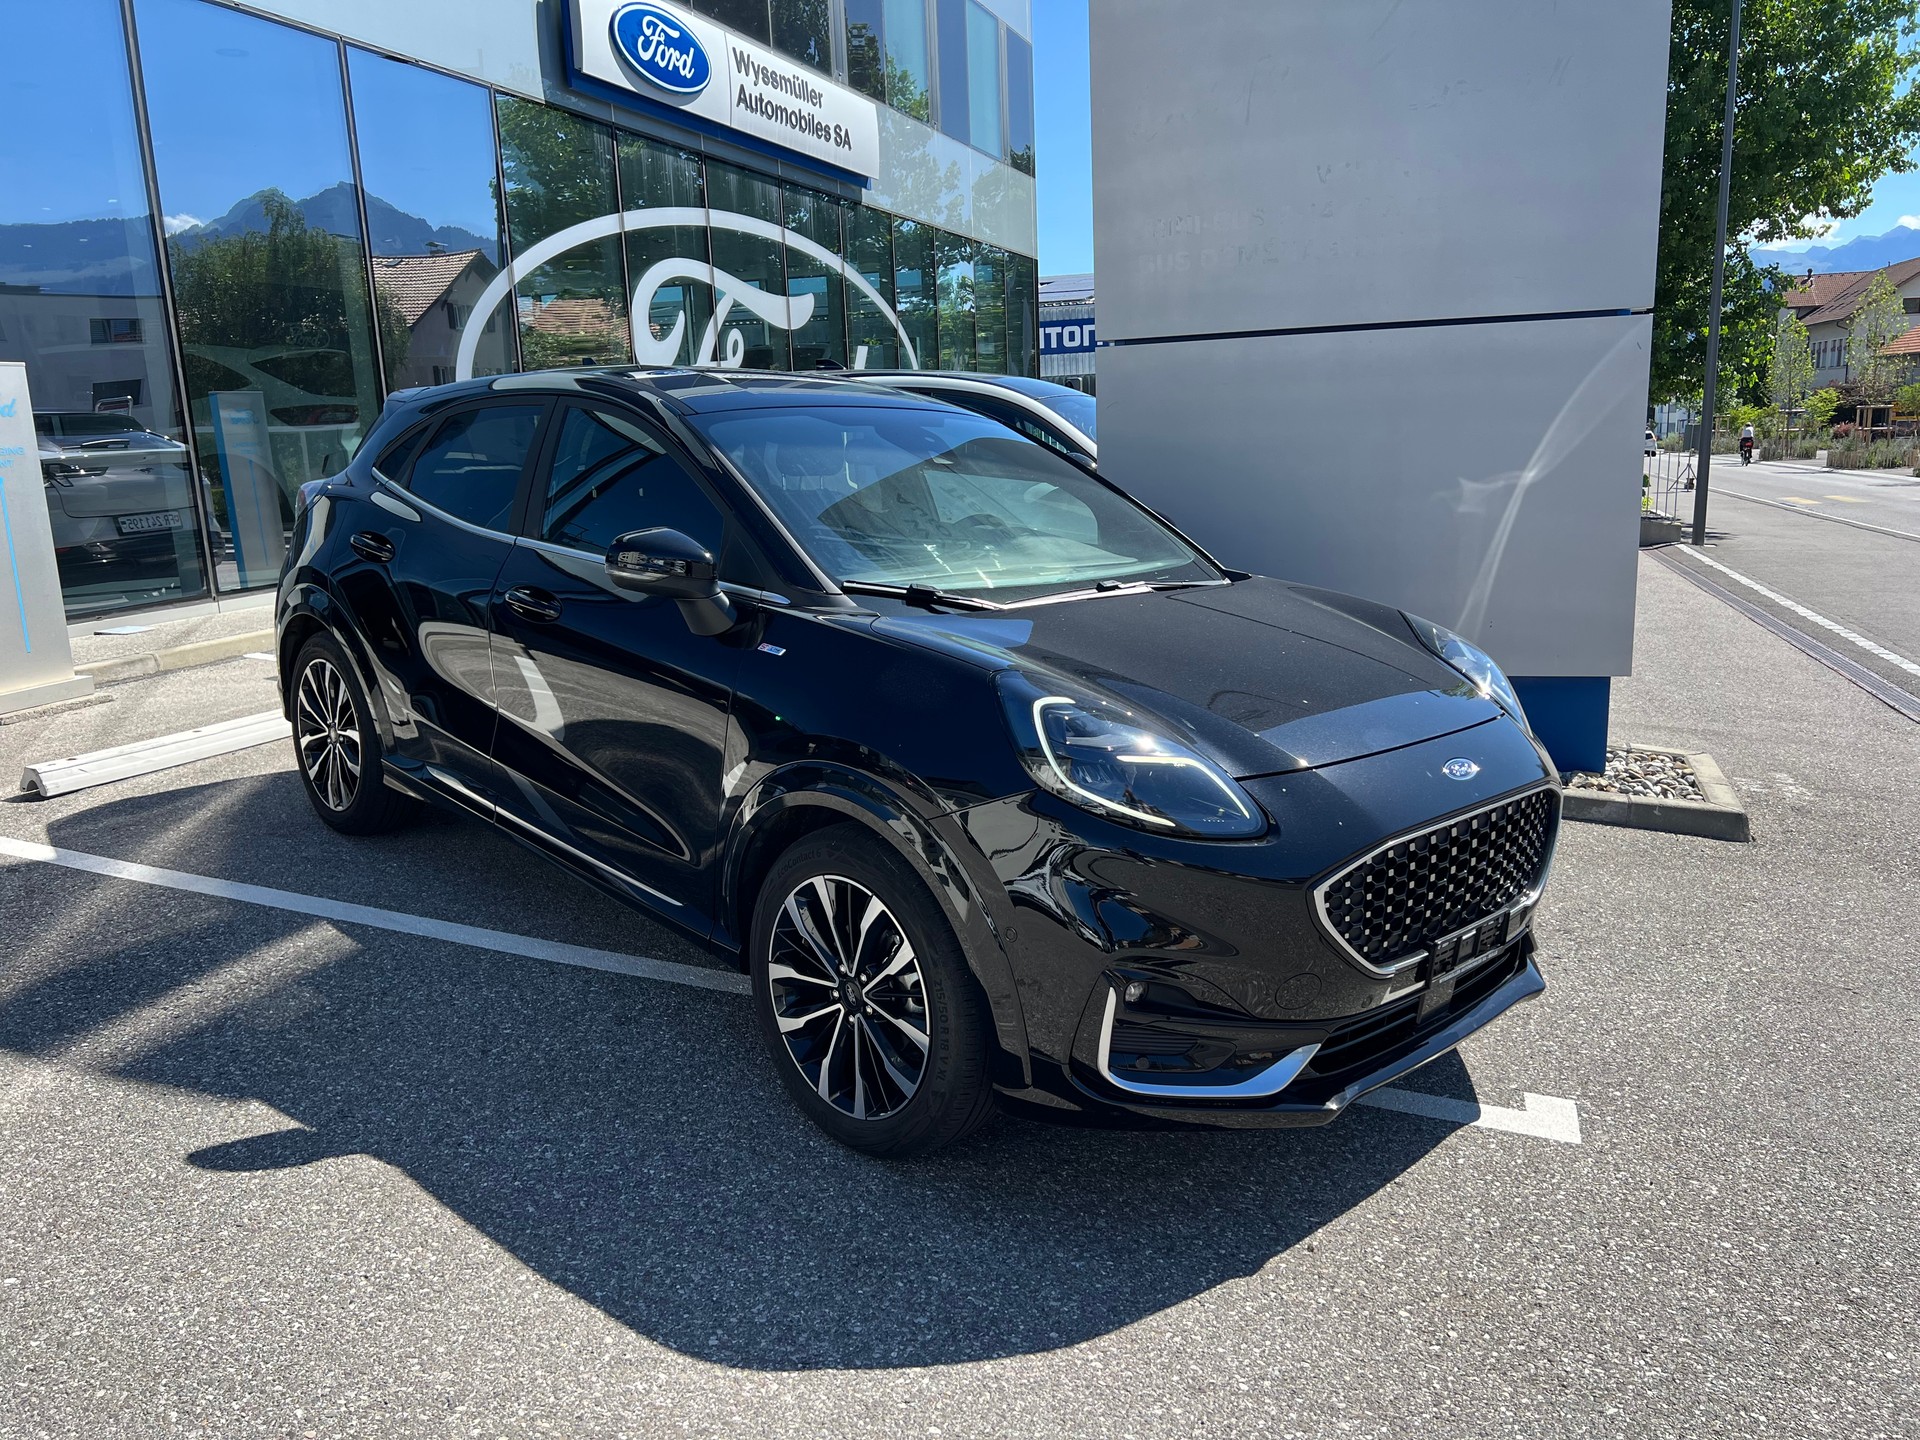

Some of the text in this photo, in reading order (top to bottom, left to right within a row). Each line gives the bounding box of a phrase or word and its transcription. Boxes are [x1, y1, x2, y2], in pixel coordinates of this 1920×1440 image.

[638, 15, 695, 79] Ford
[732, 46, 824, 109] Wyssmüller
[736, 83, 853, 152] Automobiles SA
[933, 978, 949, 1024] 215/50
[939, 1026, 950, 1036] R
[939, 1038, 950, 1052] 18
[935, 1067, 948, 1082] XL
